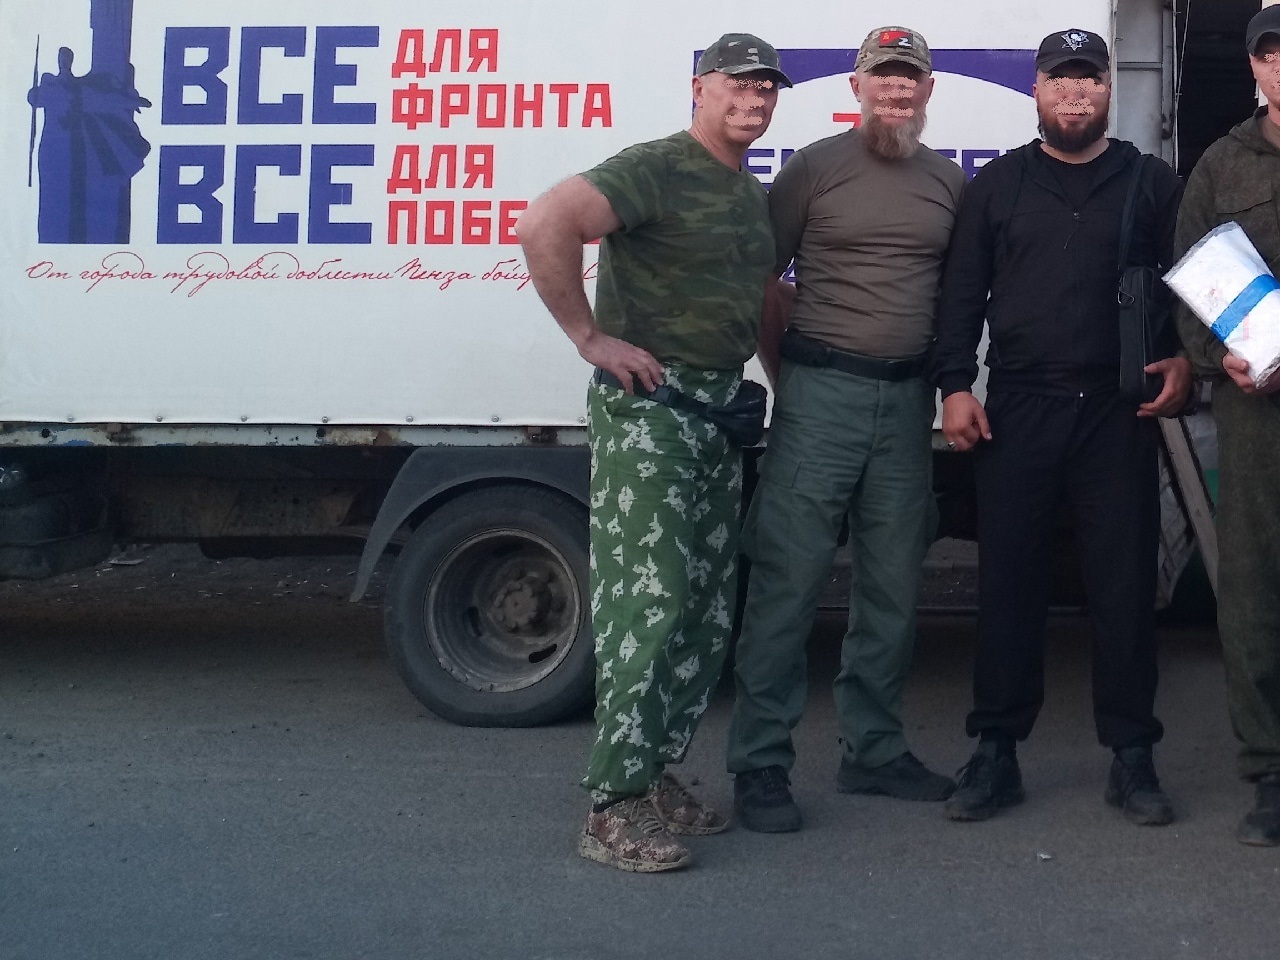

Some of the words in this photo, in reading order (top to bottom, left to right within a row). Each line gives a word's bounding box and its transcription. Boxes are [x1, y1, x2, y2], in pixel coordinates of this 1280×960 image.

[160, 25, 380, 126] ВСЕ
[391, 28, 499, 78] ДЛЯ
[391, 82, 612, 131] ФРОНТА
[156, 144, 376, 245] ВСЕ
[387, 144, 495, 195] ДЛЯ
[387, 201, 526, 245] ПОБЕ
[26, 261, 72, 279] От
[80, 251, 157, 293] города
[163, 251, 280, 298] трудовой
[284, 251, 393, 281] доблести
